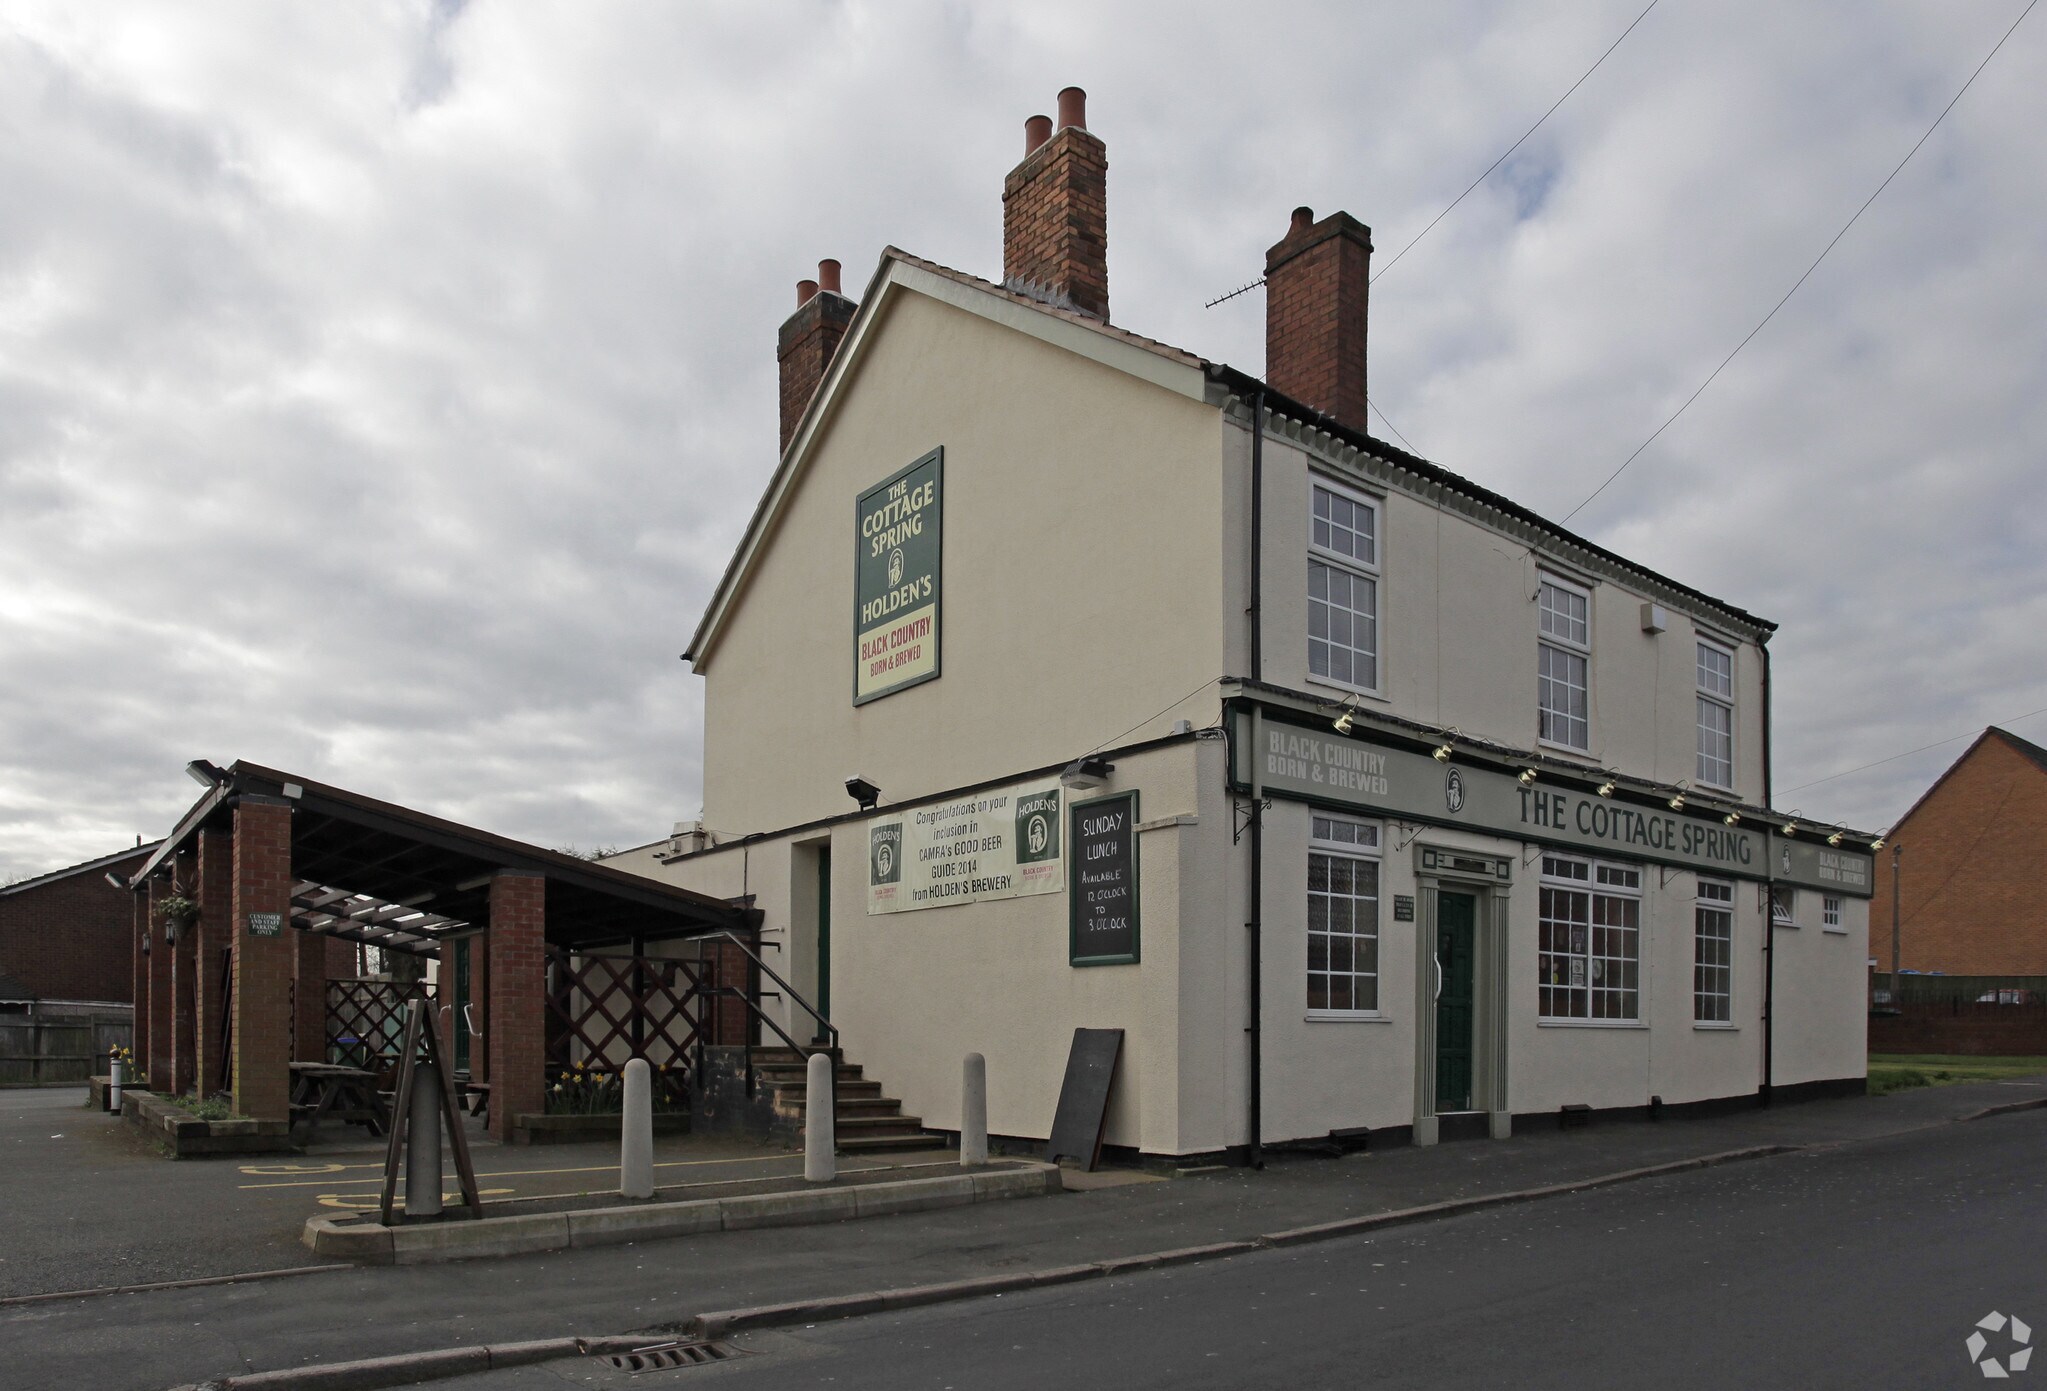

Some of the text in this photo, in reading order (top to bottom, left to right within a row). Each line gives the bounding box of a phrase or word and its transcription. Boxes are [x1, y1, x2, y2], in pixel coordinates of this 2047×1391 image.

[888, 479, 907, 500] THE
[862, 480, 934, 538] COTTAGE
[871, 513, 922, 557] SPRING
[862, 574, 932, 625] HOLDEN'S
[862, 615, 932, 661] BLACK COUNTRY
[870, 645, 921, 677] BORN & BREWED
[1269, 731, 1386, 776] BLACK COUNTRY
[1267, 754, 1388, 795] BORN & BREWED
[916, 796, 1008, 825] Congratulations on your
[1018, 799, 1057, 818] HOLDEN'S
[933, 820, 978, 840] inclusion in
[1083, 812, 1124, 837] SUNDAY
[1516, 786, 1750, 865] THE COTTAGE SPRING
[872, 830, 900, 847] HOLDEN'S
[919, 835, 1003, 862] CAMRA's GOOD BEER
[1087, 841, 1118, 861] LUNCH
[931, 859, 978, 879] GUIDE 2014
[912, 874, 1012, 901] from HOLDEN'S BREWERY
[1087, 891, 1096, 902] 12
[1095, 905, 1106, 914] TO
[1088, 917, 1127, 931] 3 O'COCK
